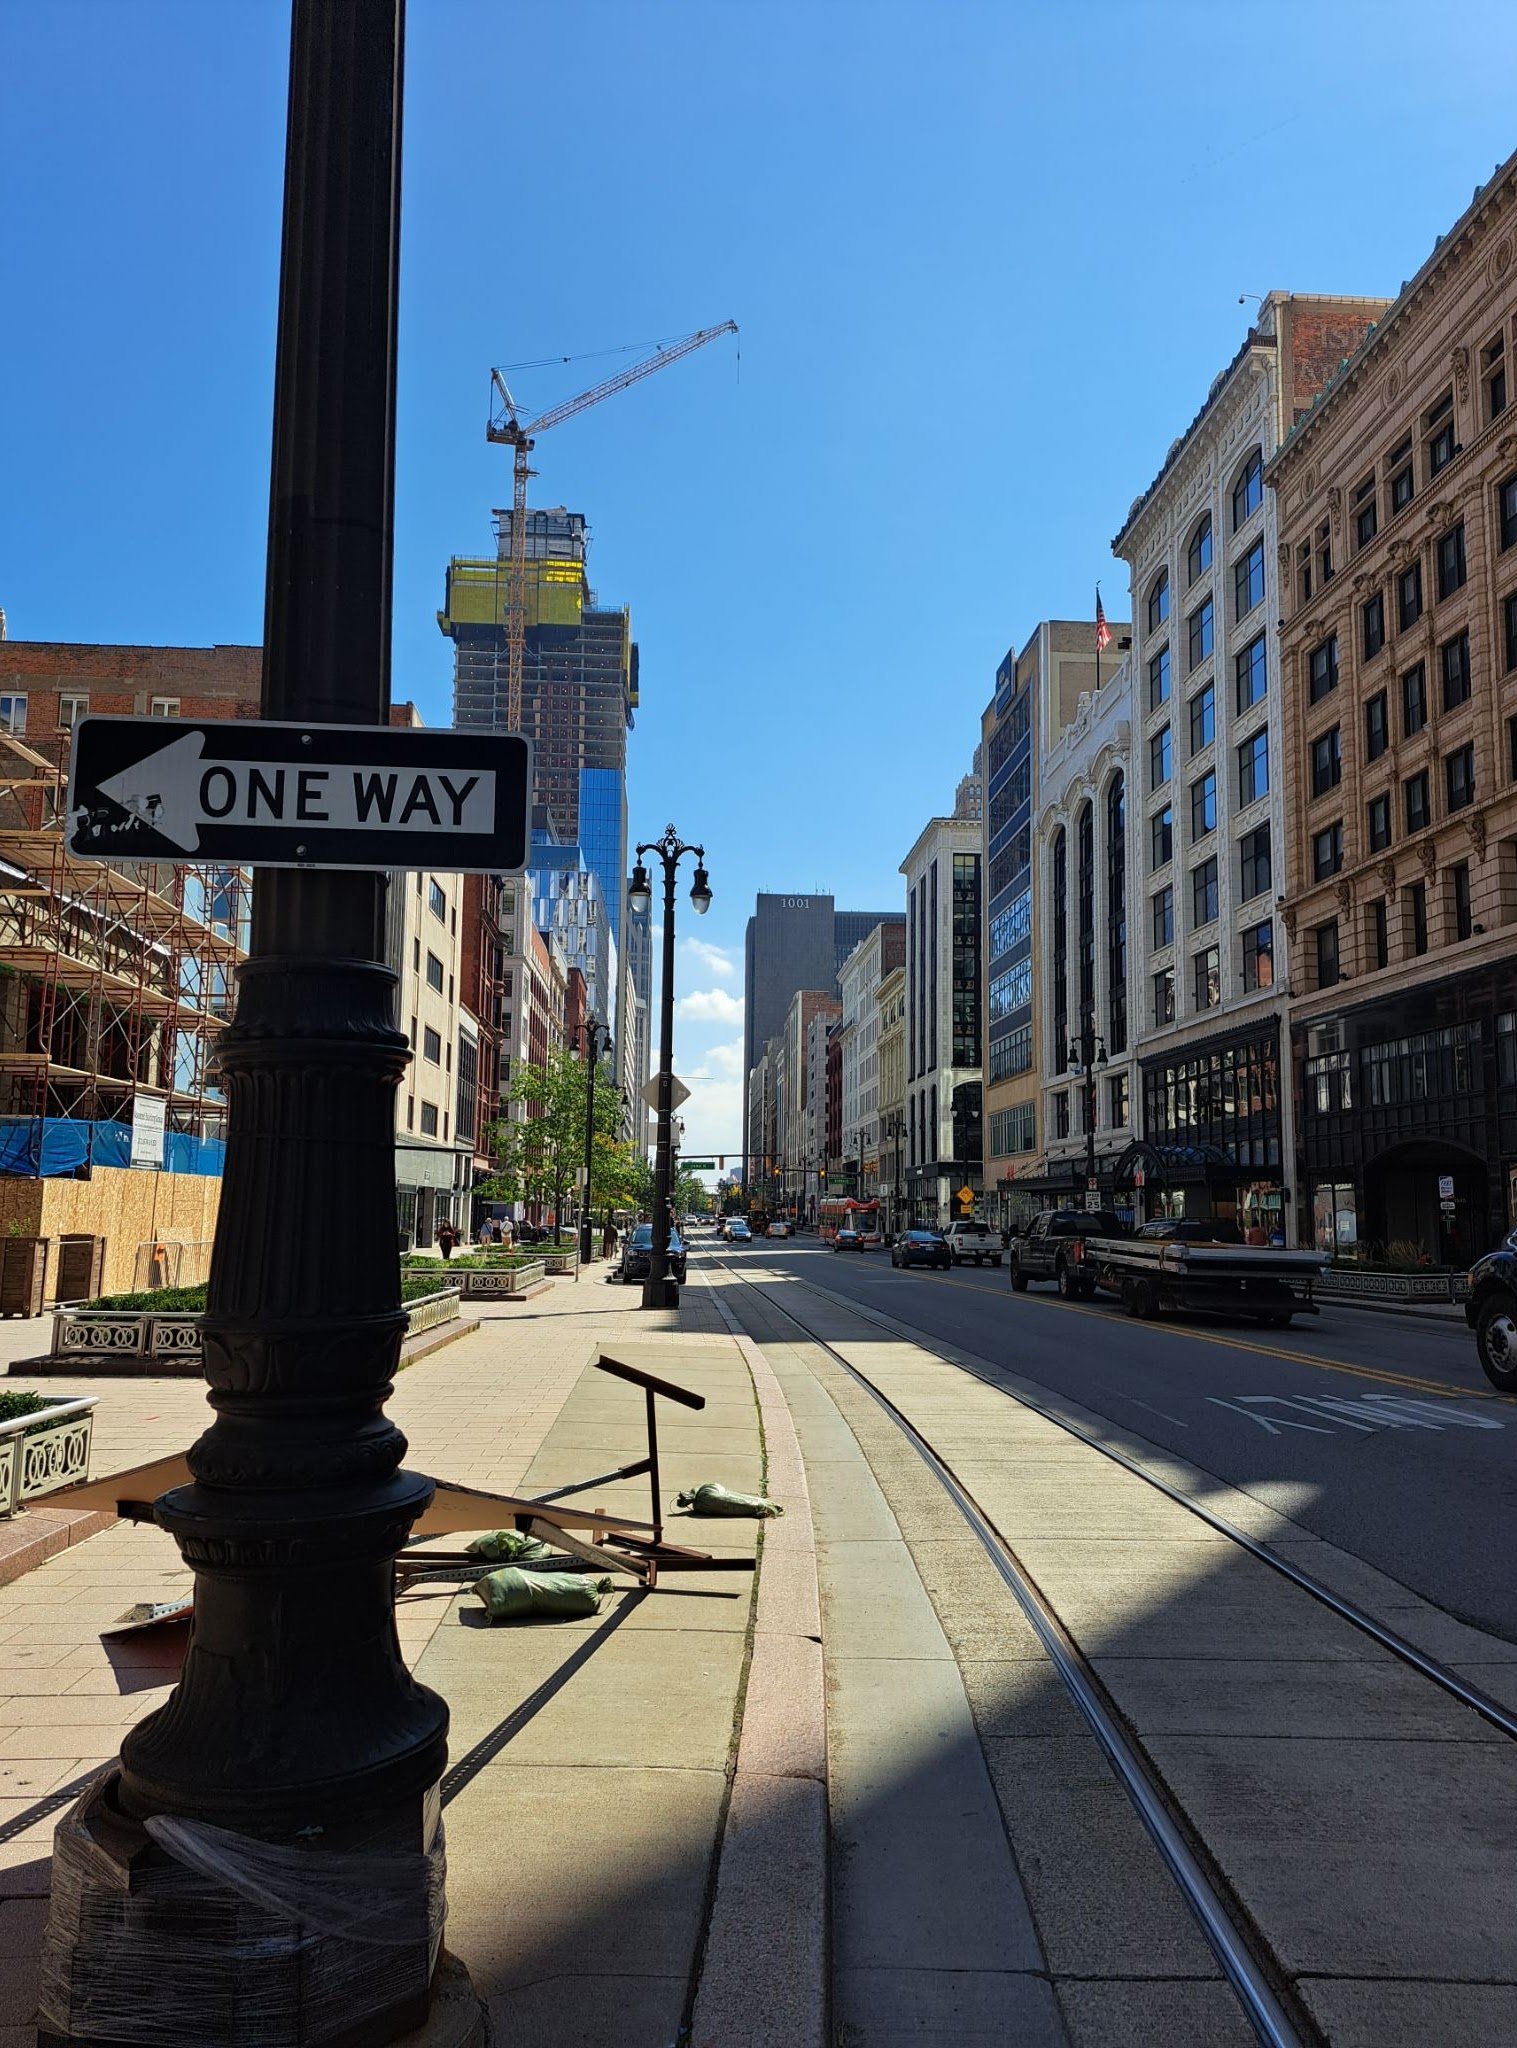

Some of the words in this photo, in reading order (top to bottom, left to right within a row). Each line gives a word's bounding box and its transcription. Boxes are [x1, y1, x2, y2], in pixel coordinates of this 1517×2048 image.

[199, 765, 330, 821] ONE
[352, 772, 481, 826] WAY
[781, 897, 810, 909] 1001
[1087, 1201, 1099, 1209] 25
